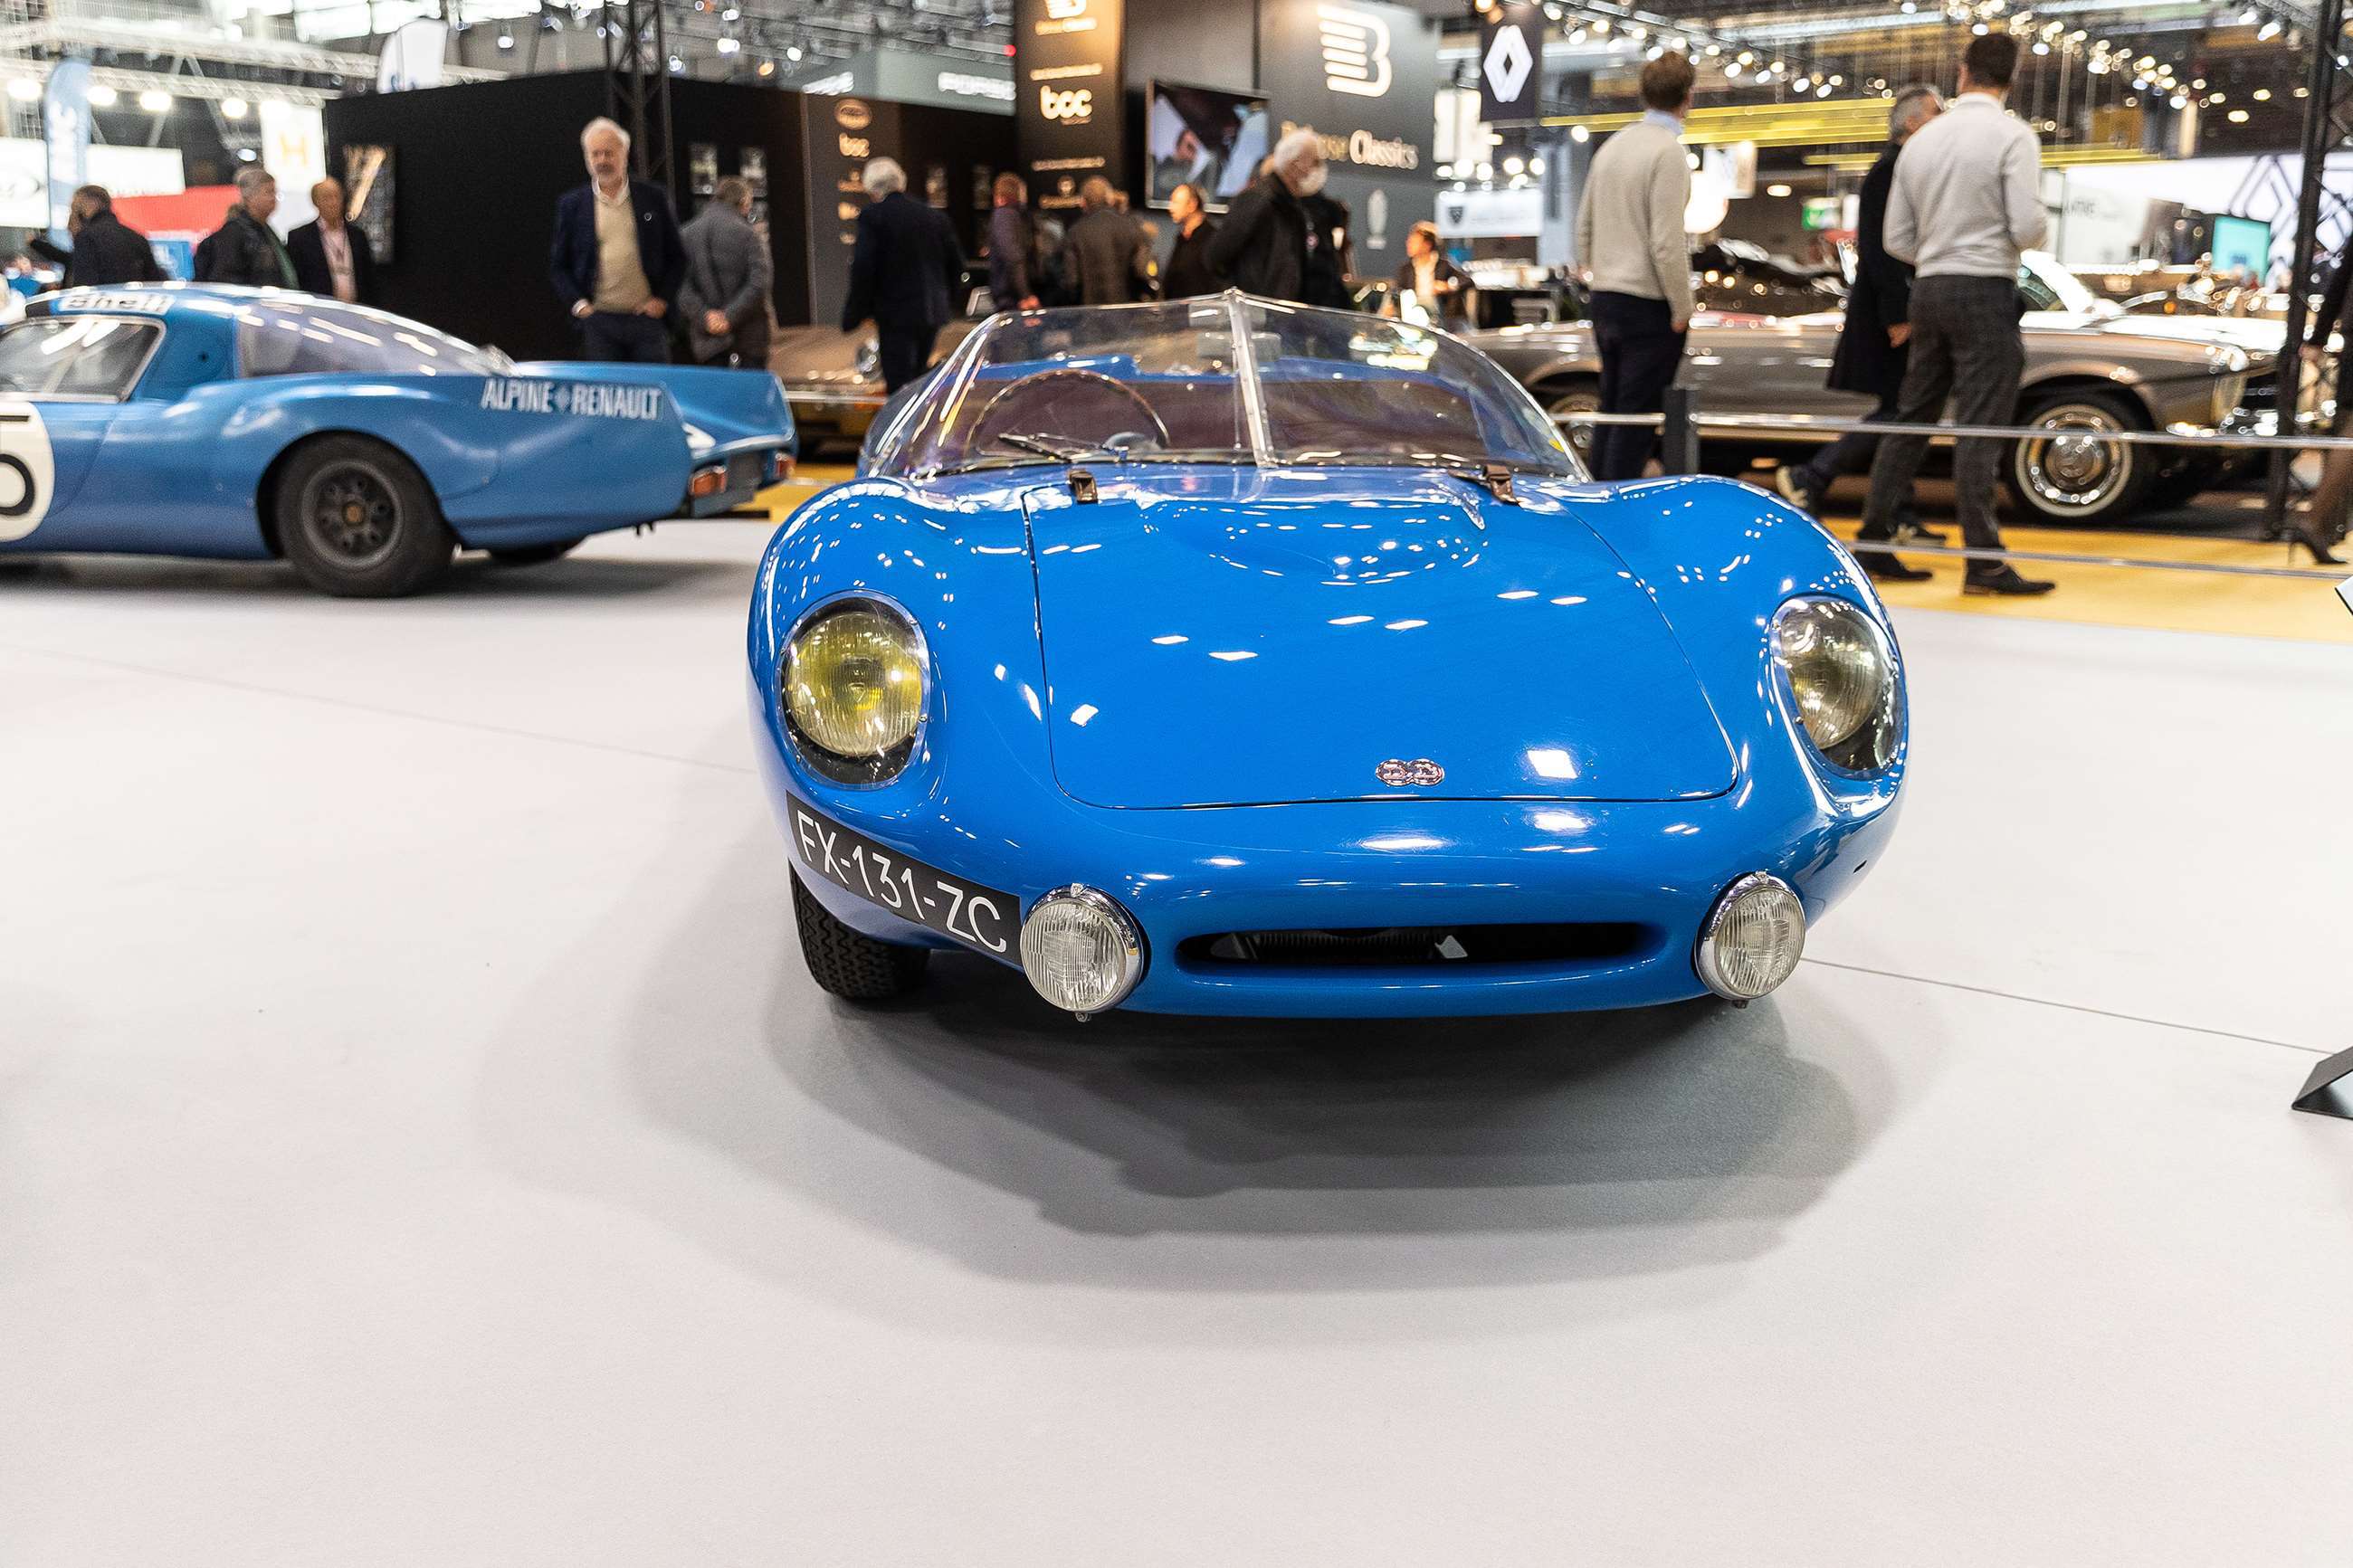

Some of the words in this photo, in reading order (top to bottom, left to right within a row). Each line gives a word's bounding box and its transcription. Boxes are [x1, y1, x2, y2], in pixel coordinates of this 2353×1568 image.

[481, 377, 553, 413] ALPINE
[571, 383, 662, 421] RENAULT
[797, 810, 1007, 954] FX-131-ZC
